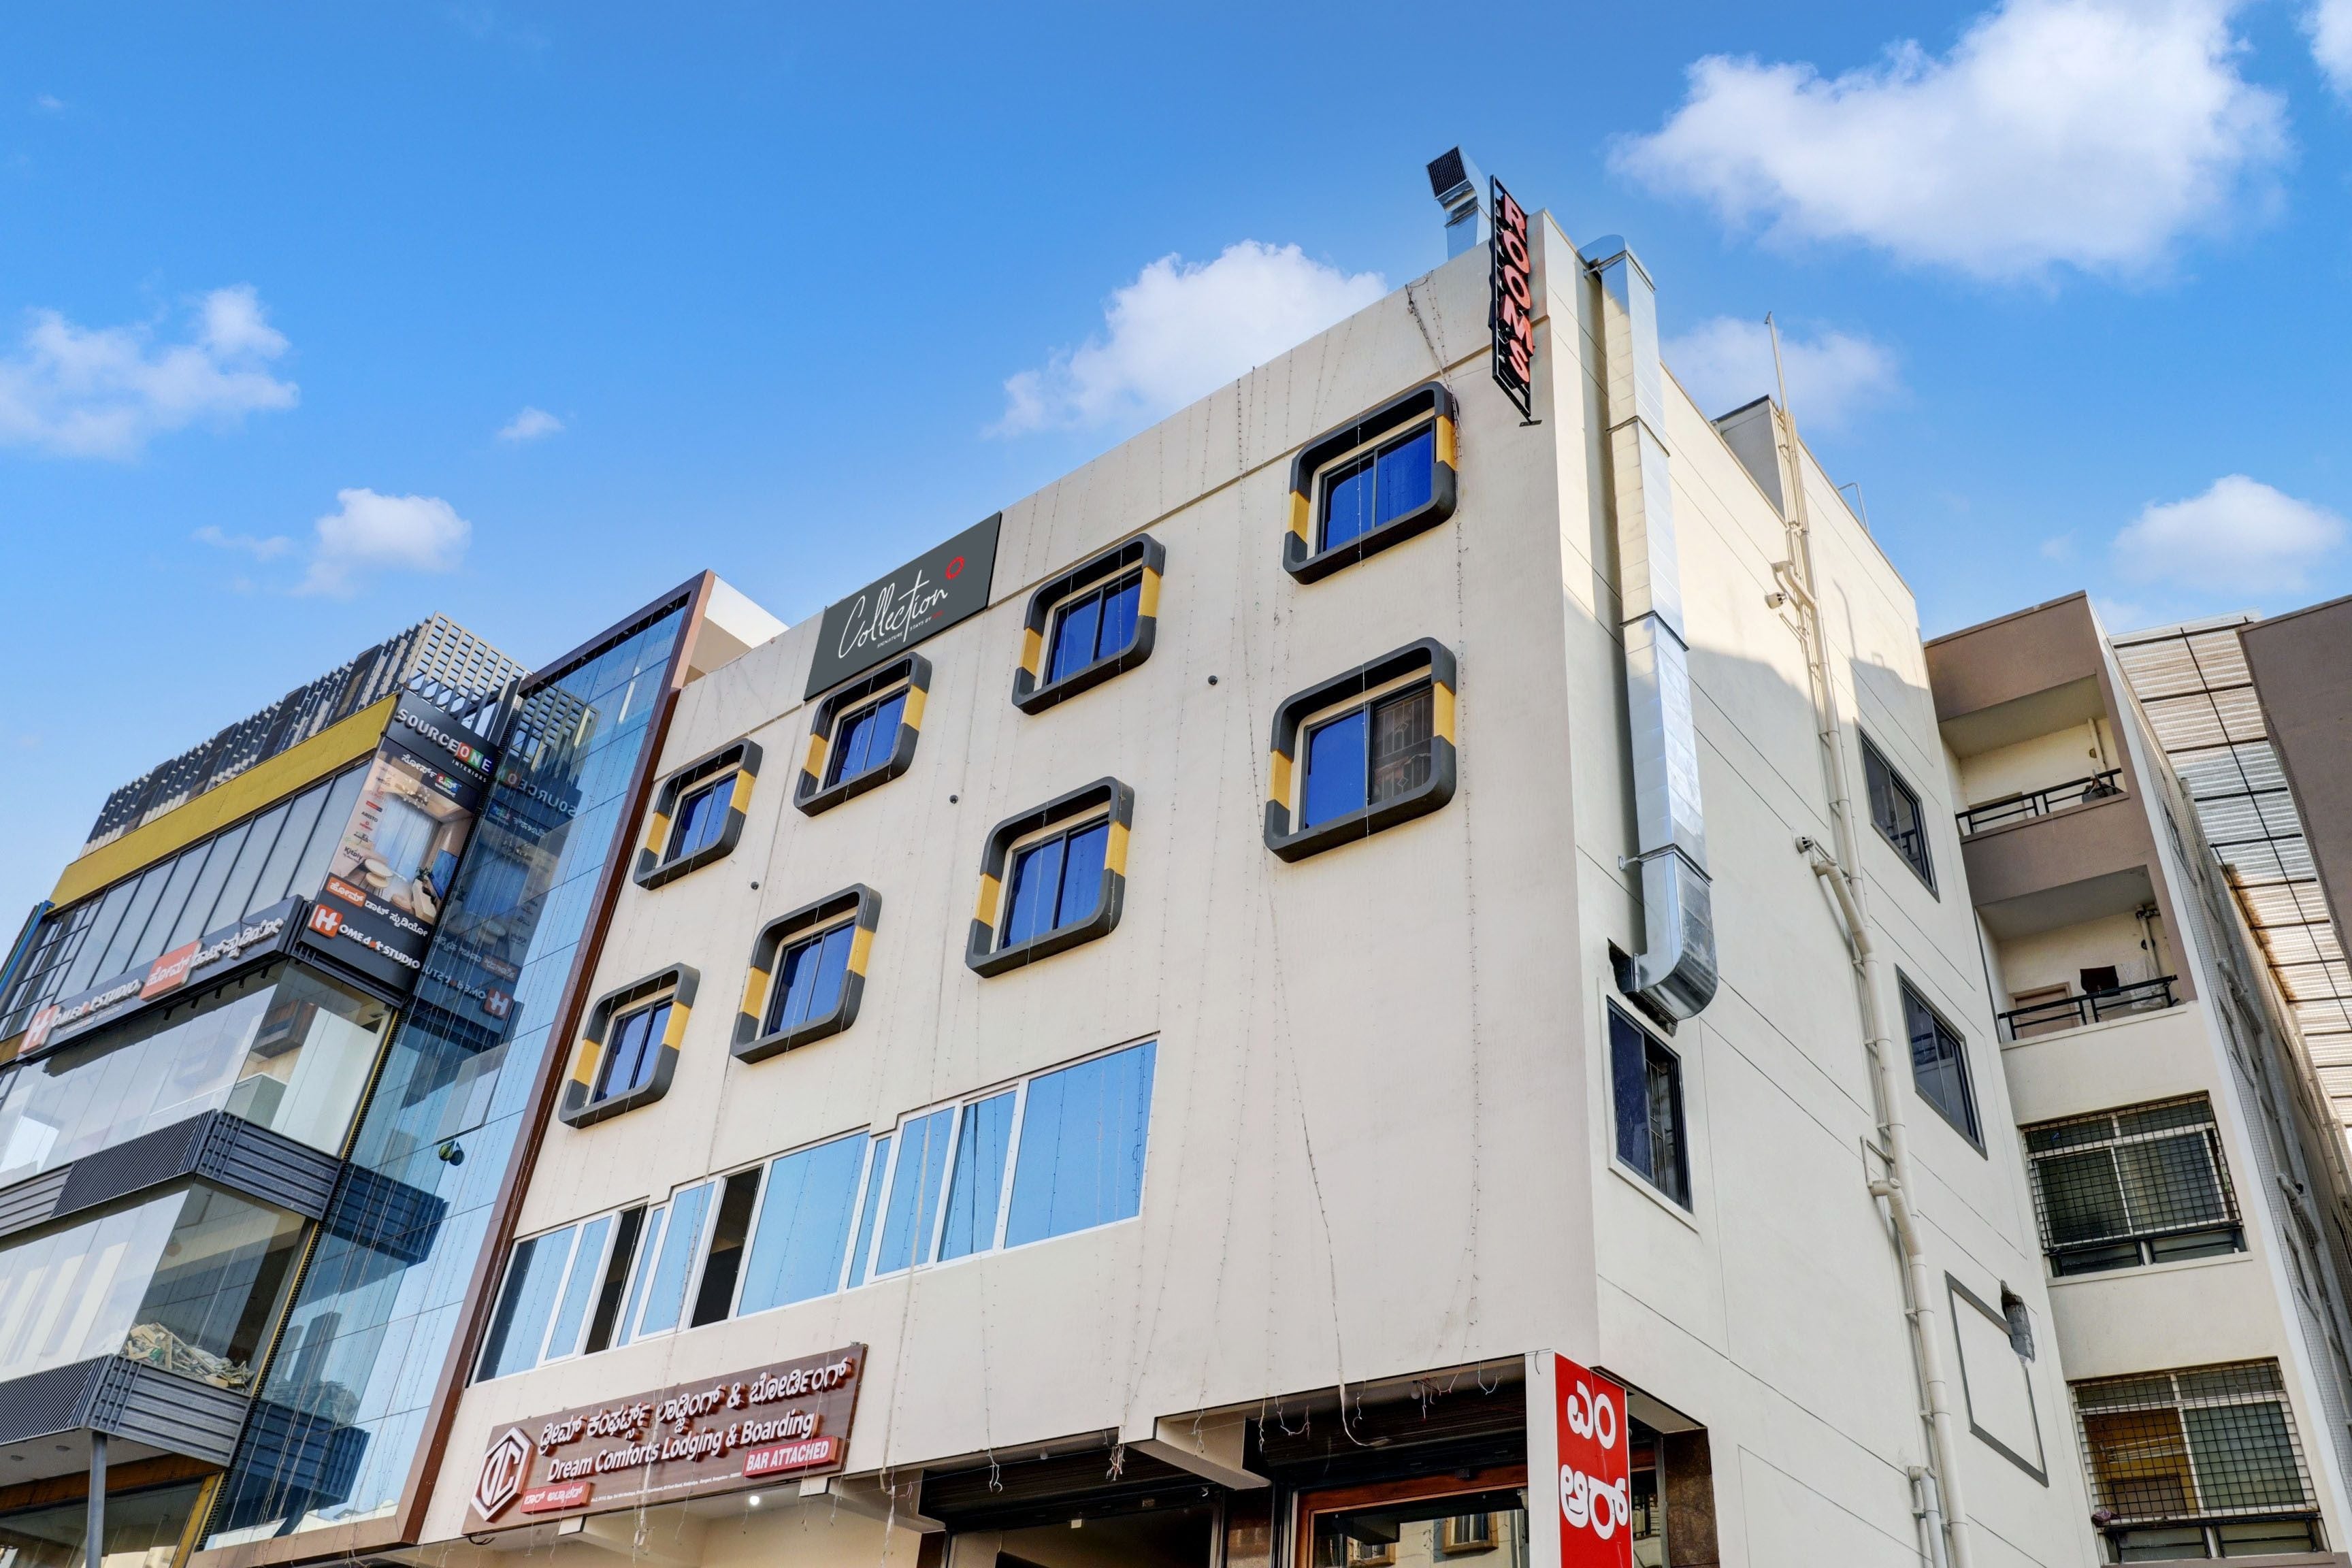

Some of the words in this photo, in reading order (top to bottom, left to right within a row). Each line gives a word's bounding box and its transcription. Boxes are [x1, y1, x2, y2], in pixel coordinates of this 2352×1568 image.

[1501, 193, 1534, 383] ROOMS
[838, 570, 948, 659] Collection
[452, 759, 487, 783] INTERIORS
[361, 811, 378, 823] ARISTO
[344, 847, 363, 861] Kitply
[538, 1415, 583, 1456] ಡ್ರೀಮ್
[727, 1382, 741, 1409] &
[546, 1456, 593, 1482] Dream
[595, 1441, 661, 1473] Comforts
[661, 1426, 723, 1461] Lodging
[725, 1423, 737, 1448] &
[740, 1408, 815, 1445] Boarding
[1567, 1379, 1616, 1450] ಎಂ
[746, 1451, 770, 1472] BAR
[770, 1440, 830, 1467] ATTACHED
[1560, 1464, 1629, 1540] ಆರ್
